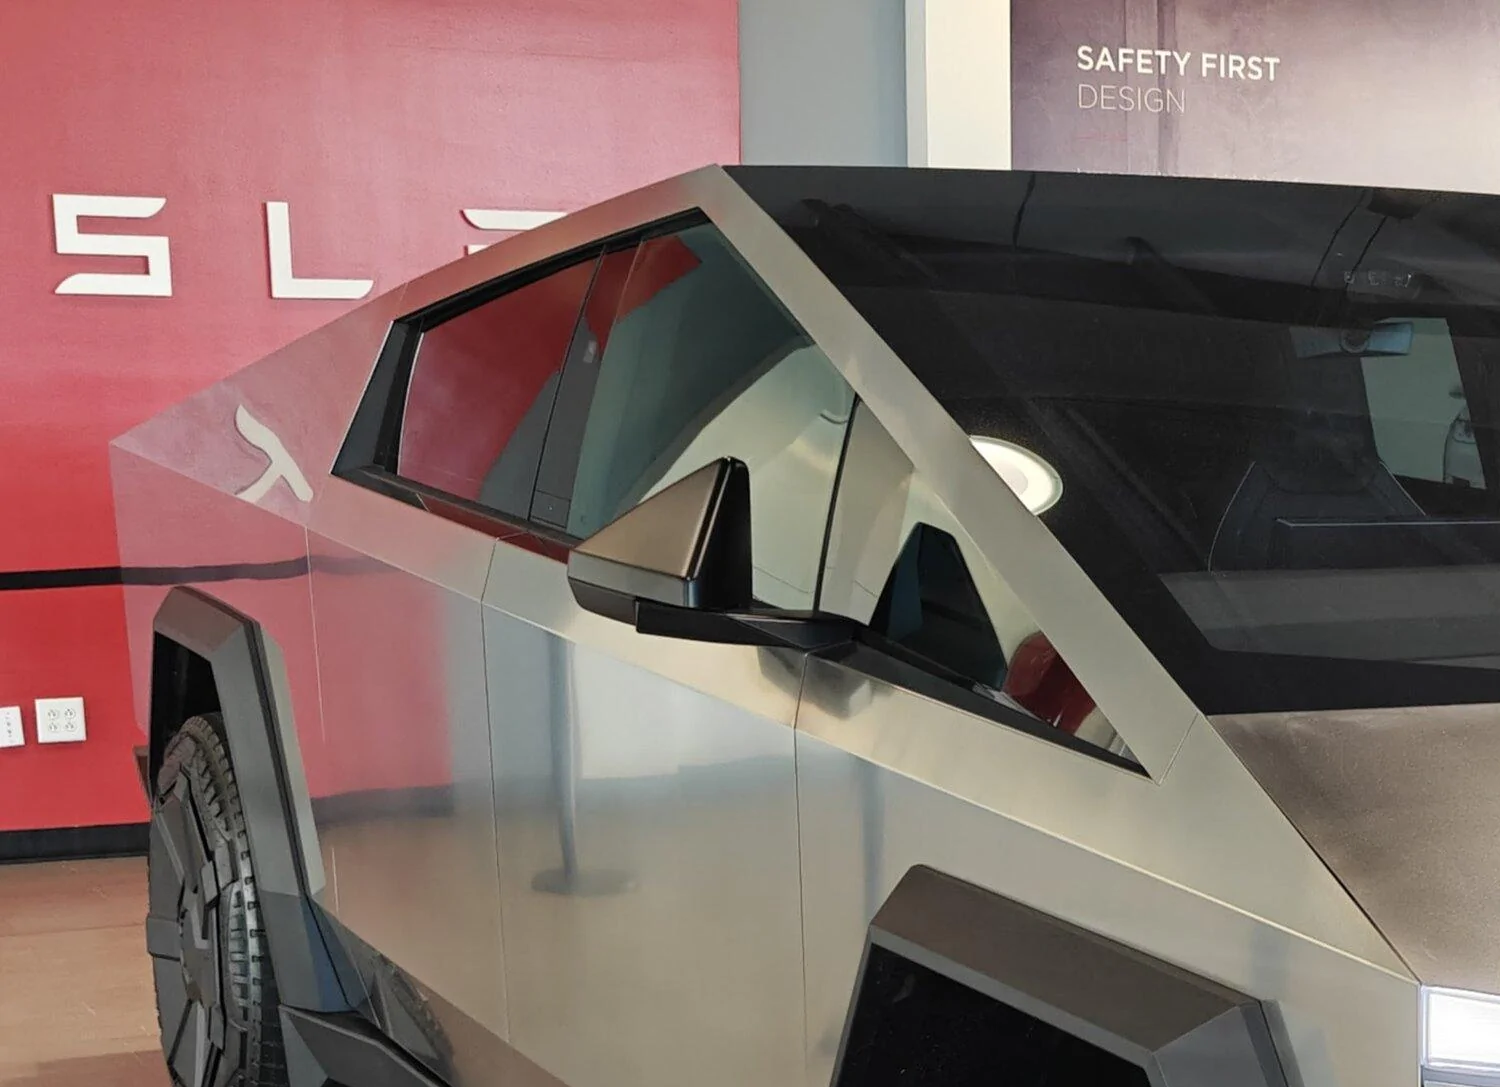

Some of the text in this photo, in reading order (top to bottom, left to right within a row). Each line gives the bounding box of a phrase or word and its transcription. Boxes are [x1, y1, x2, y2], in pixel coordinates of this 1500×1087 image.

[1076, 45, 1281, 81] SAFETY FIRST
[1077, 83, 1186, 114] DESIGN
